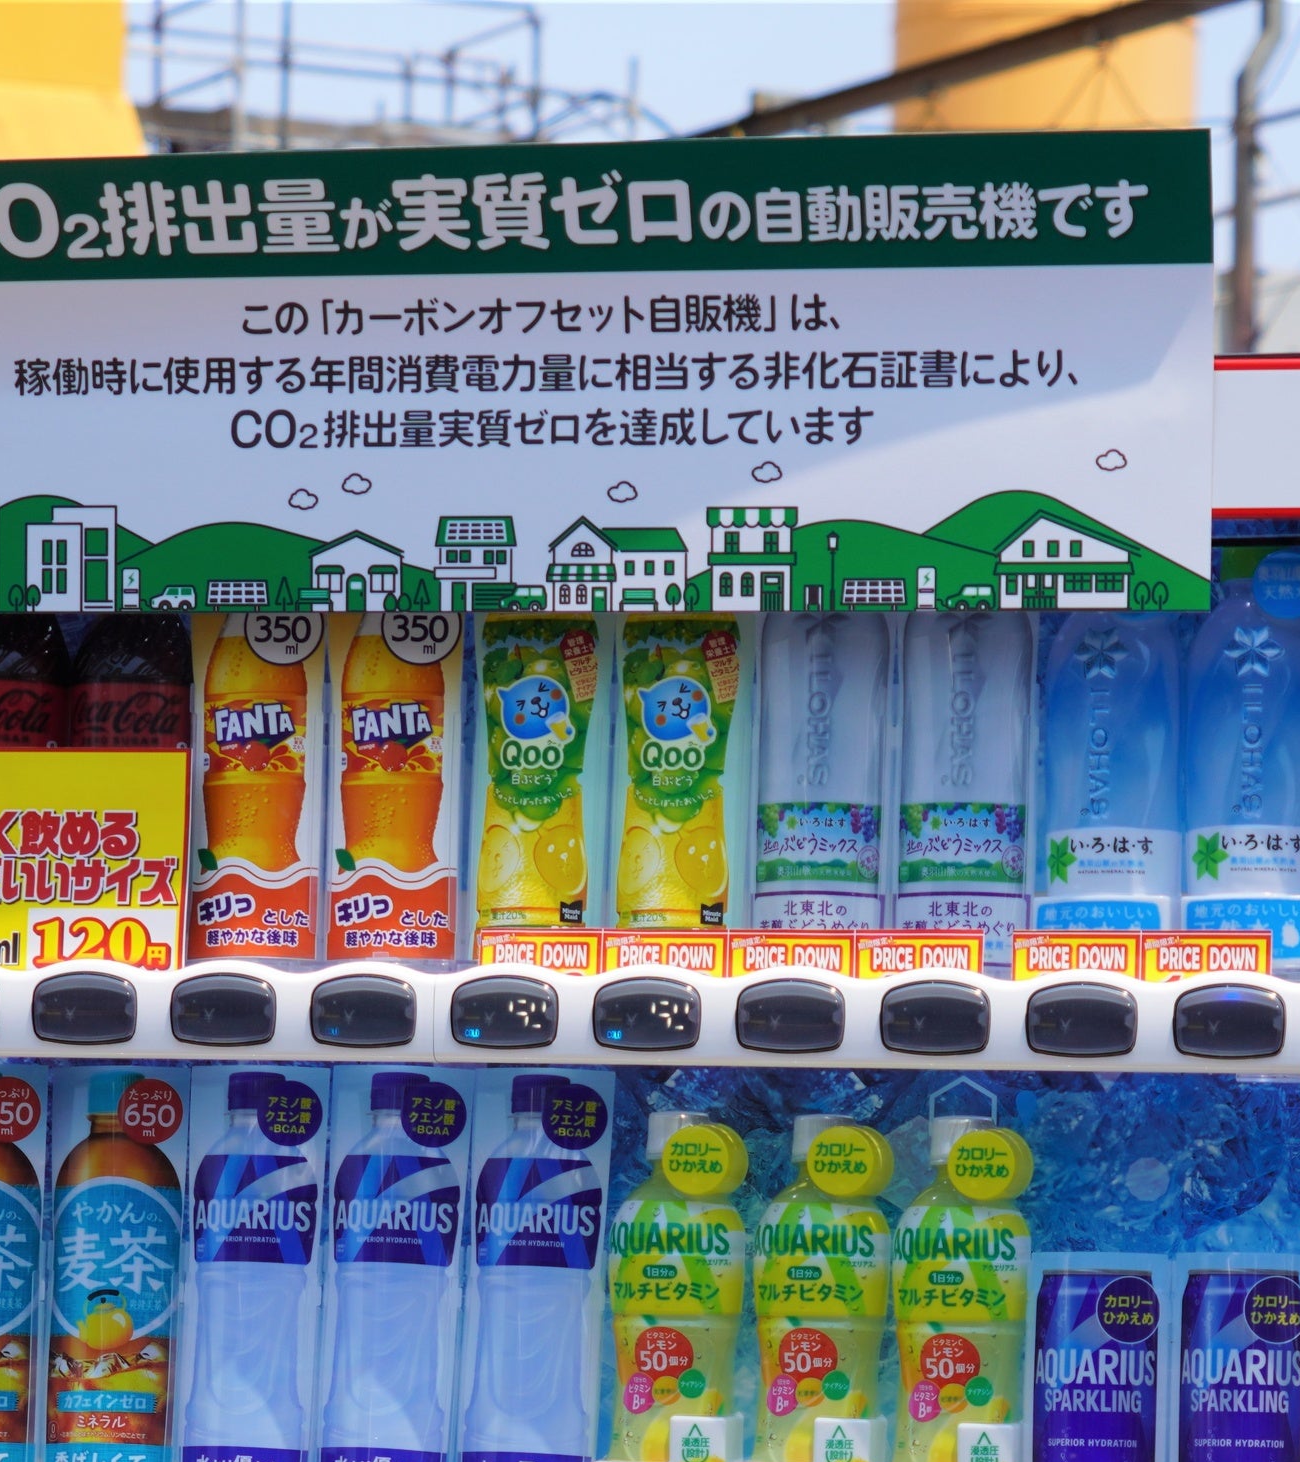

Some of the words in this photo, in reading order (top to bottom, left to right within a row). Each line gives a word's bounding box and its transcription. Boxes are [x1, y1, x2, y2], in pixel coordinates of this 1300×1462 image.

[241, 294, 840, 336] この「カーボンオフセット自販機」は、
[13, 349, 1079, 396] 稼働時に使用する年間消費電力量に相当する非化石証書により、
[254, 616, 311, 642] 350
[285, 643, 299, 656] ml
[215, 704, 295, 742] FANTA
[503, 741, 560, 766] Qoo
[512, 774, 551, 785] 白ぶどう
[764, 833, 857, 855] 北のぶどうミックス
[264, 910, 309, 927] とした
[784, 901, 847, 915] 北東北の
[207, 930, 298, 947] 軽やかな後味
[1030, 946, 1069, 969] PRICE
[1079, 946, 1125, 969] DOWN
[671, 1144, 721, 1158] カロリー
[668, 1158, 722, 1174] ひかえめ
[195, 1201, 311, 1231] AQUARIUS
[477, 1204, 595, 1236] AQUARIUS
[610, 1222, 730, 1262] AQUARIUS
[754, 1224, 875, 1262] AQUARIUS
[614, 1282, 719, 1302] マルチビタミン
[1036, 1349, 1155, 1386] AQUARIUS
[1045, 1389, 1141, 1413] SPARKLING
[1048, 1438, 1085, 1447] SUPERIOR
[1088, 1439, 1137, 1448] HYDRATION
